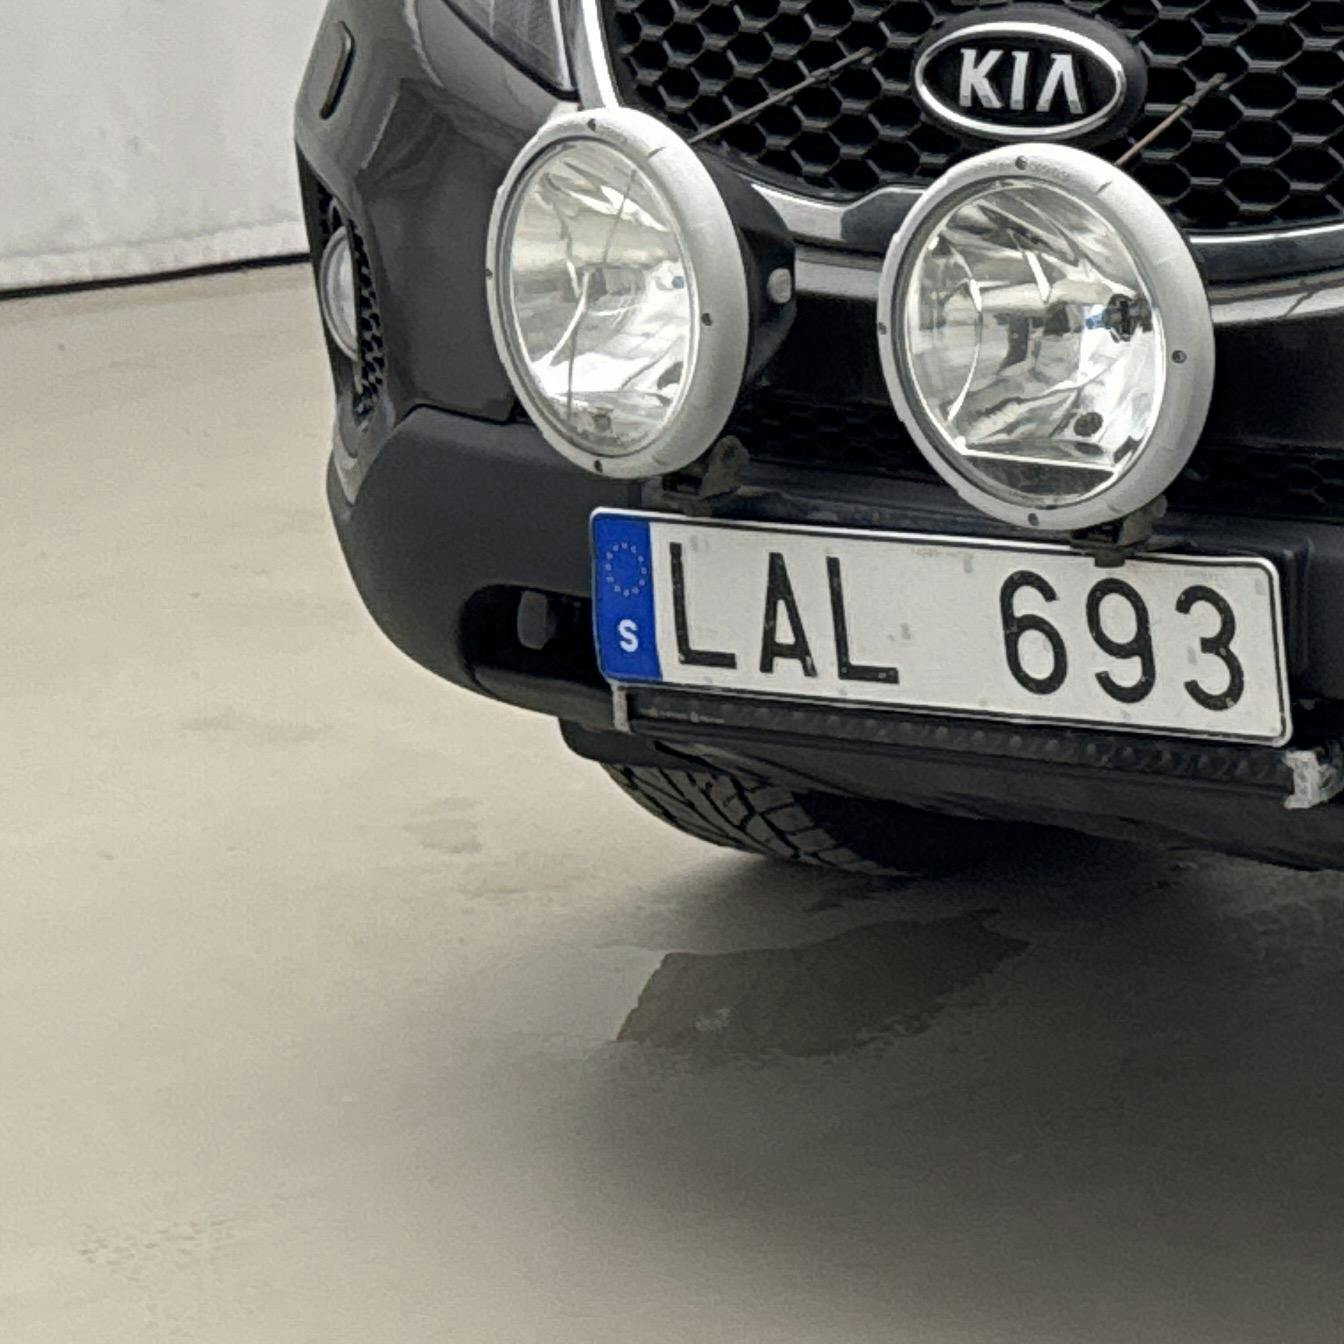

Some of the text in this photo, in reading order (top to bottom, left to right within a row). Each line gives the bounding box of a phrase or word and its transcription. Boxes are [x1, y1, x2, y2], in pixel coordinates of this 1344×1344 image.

[959, 48, 1083, 114] KIA
[618, 619, 640, 652] S
[670, 543, 1245, 711] LAL 693
